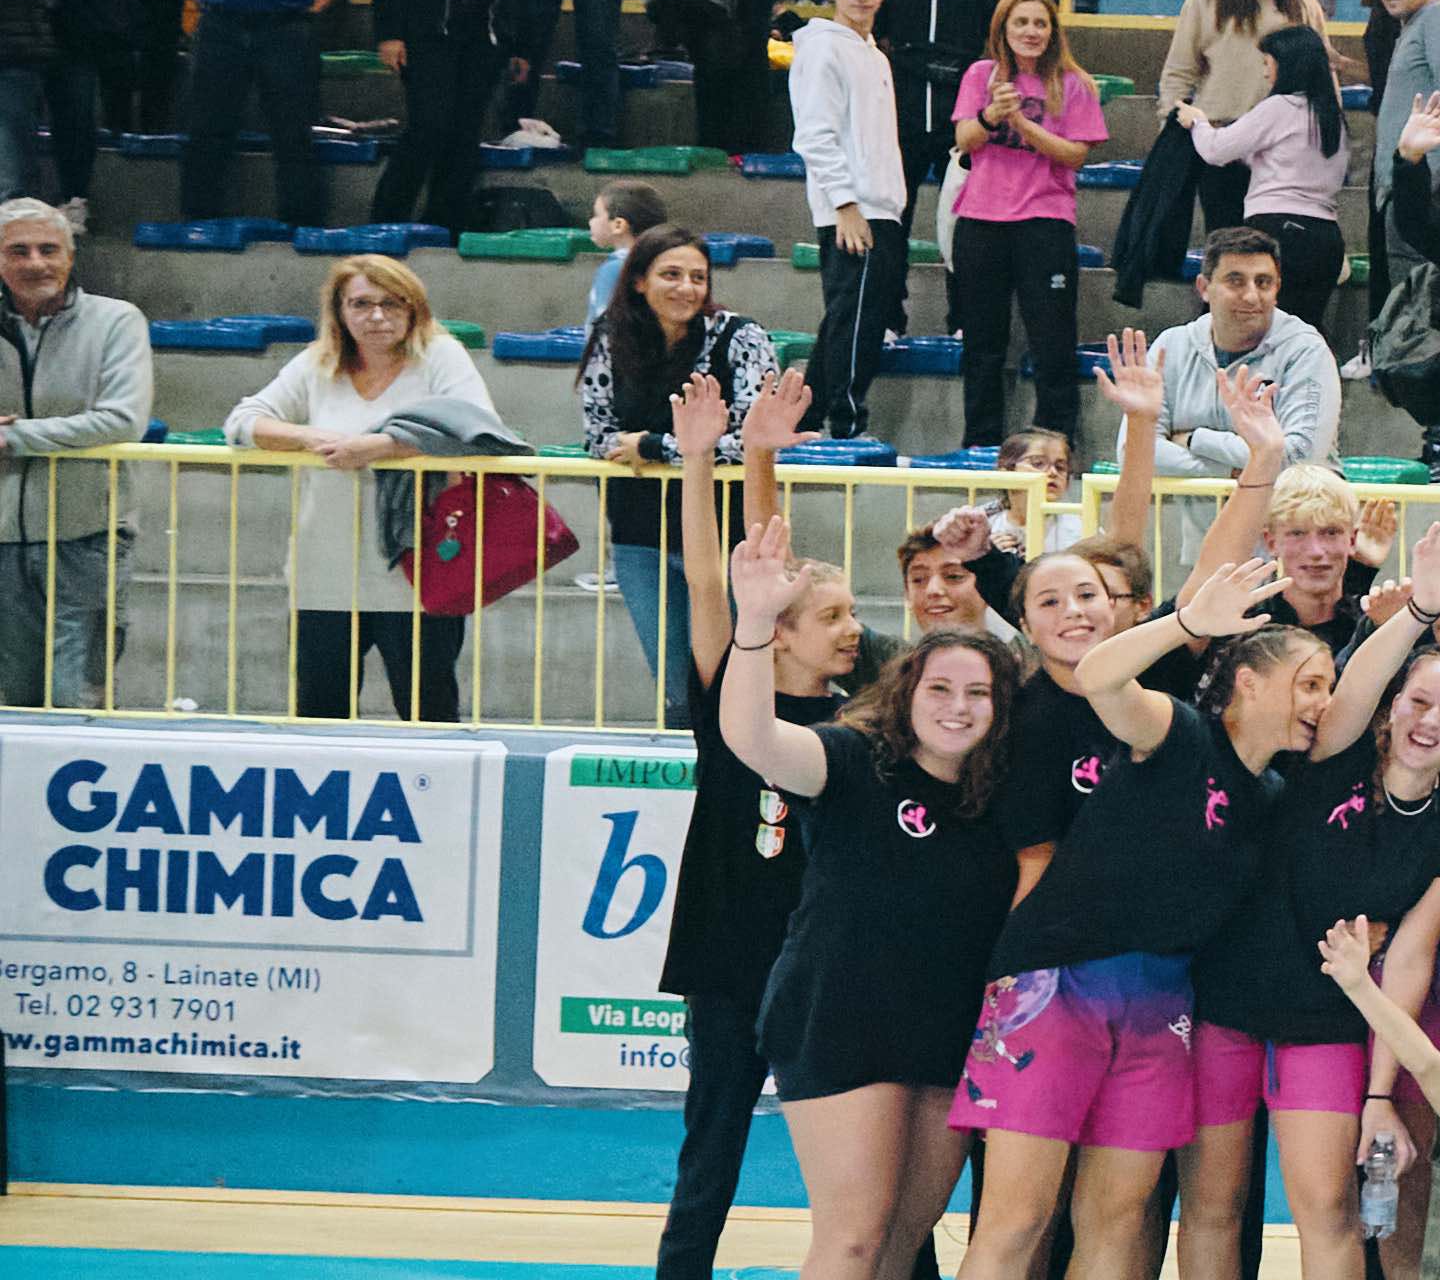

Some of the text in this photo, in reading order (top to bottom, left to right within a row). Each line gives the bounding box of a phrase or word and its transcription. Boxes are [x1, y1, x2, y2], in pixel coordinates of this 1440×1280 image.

[594, 758, 699, 787] IMPO
[46, 759, 422, 843] GAMMA
[44, 844, 424, 923] CHIMICA
[123, 961, 138, 984] 8
[164, 963, 259, 989] Lainate
[266, 966, 322, 993] (MI)
[16, 993, 236, 1022] Tel. 02 931 7901
[588, 1004, 686, 1036] Via Leop
[3, 1031, 302, 1061] w.gammachimica.it
